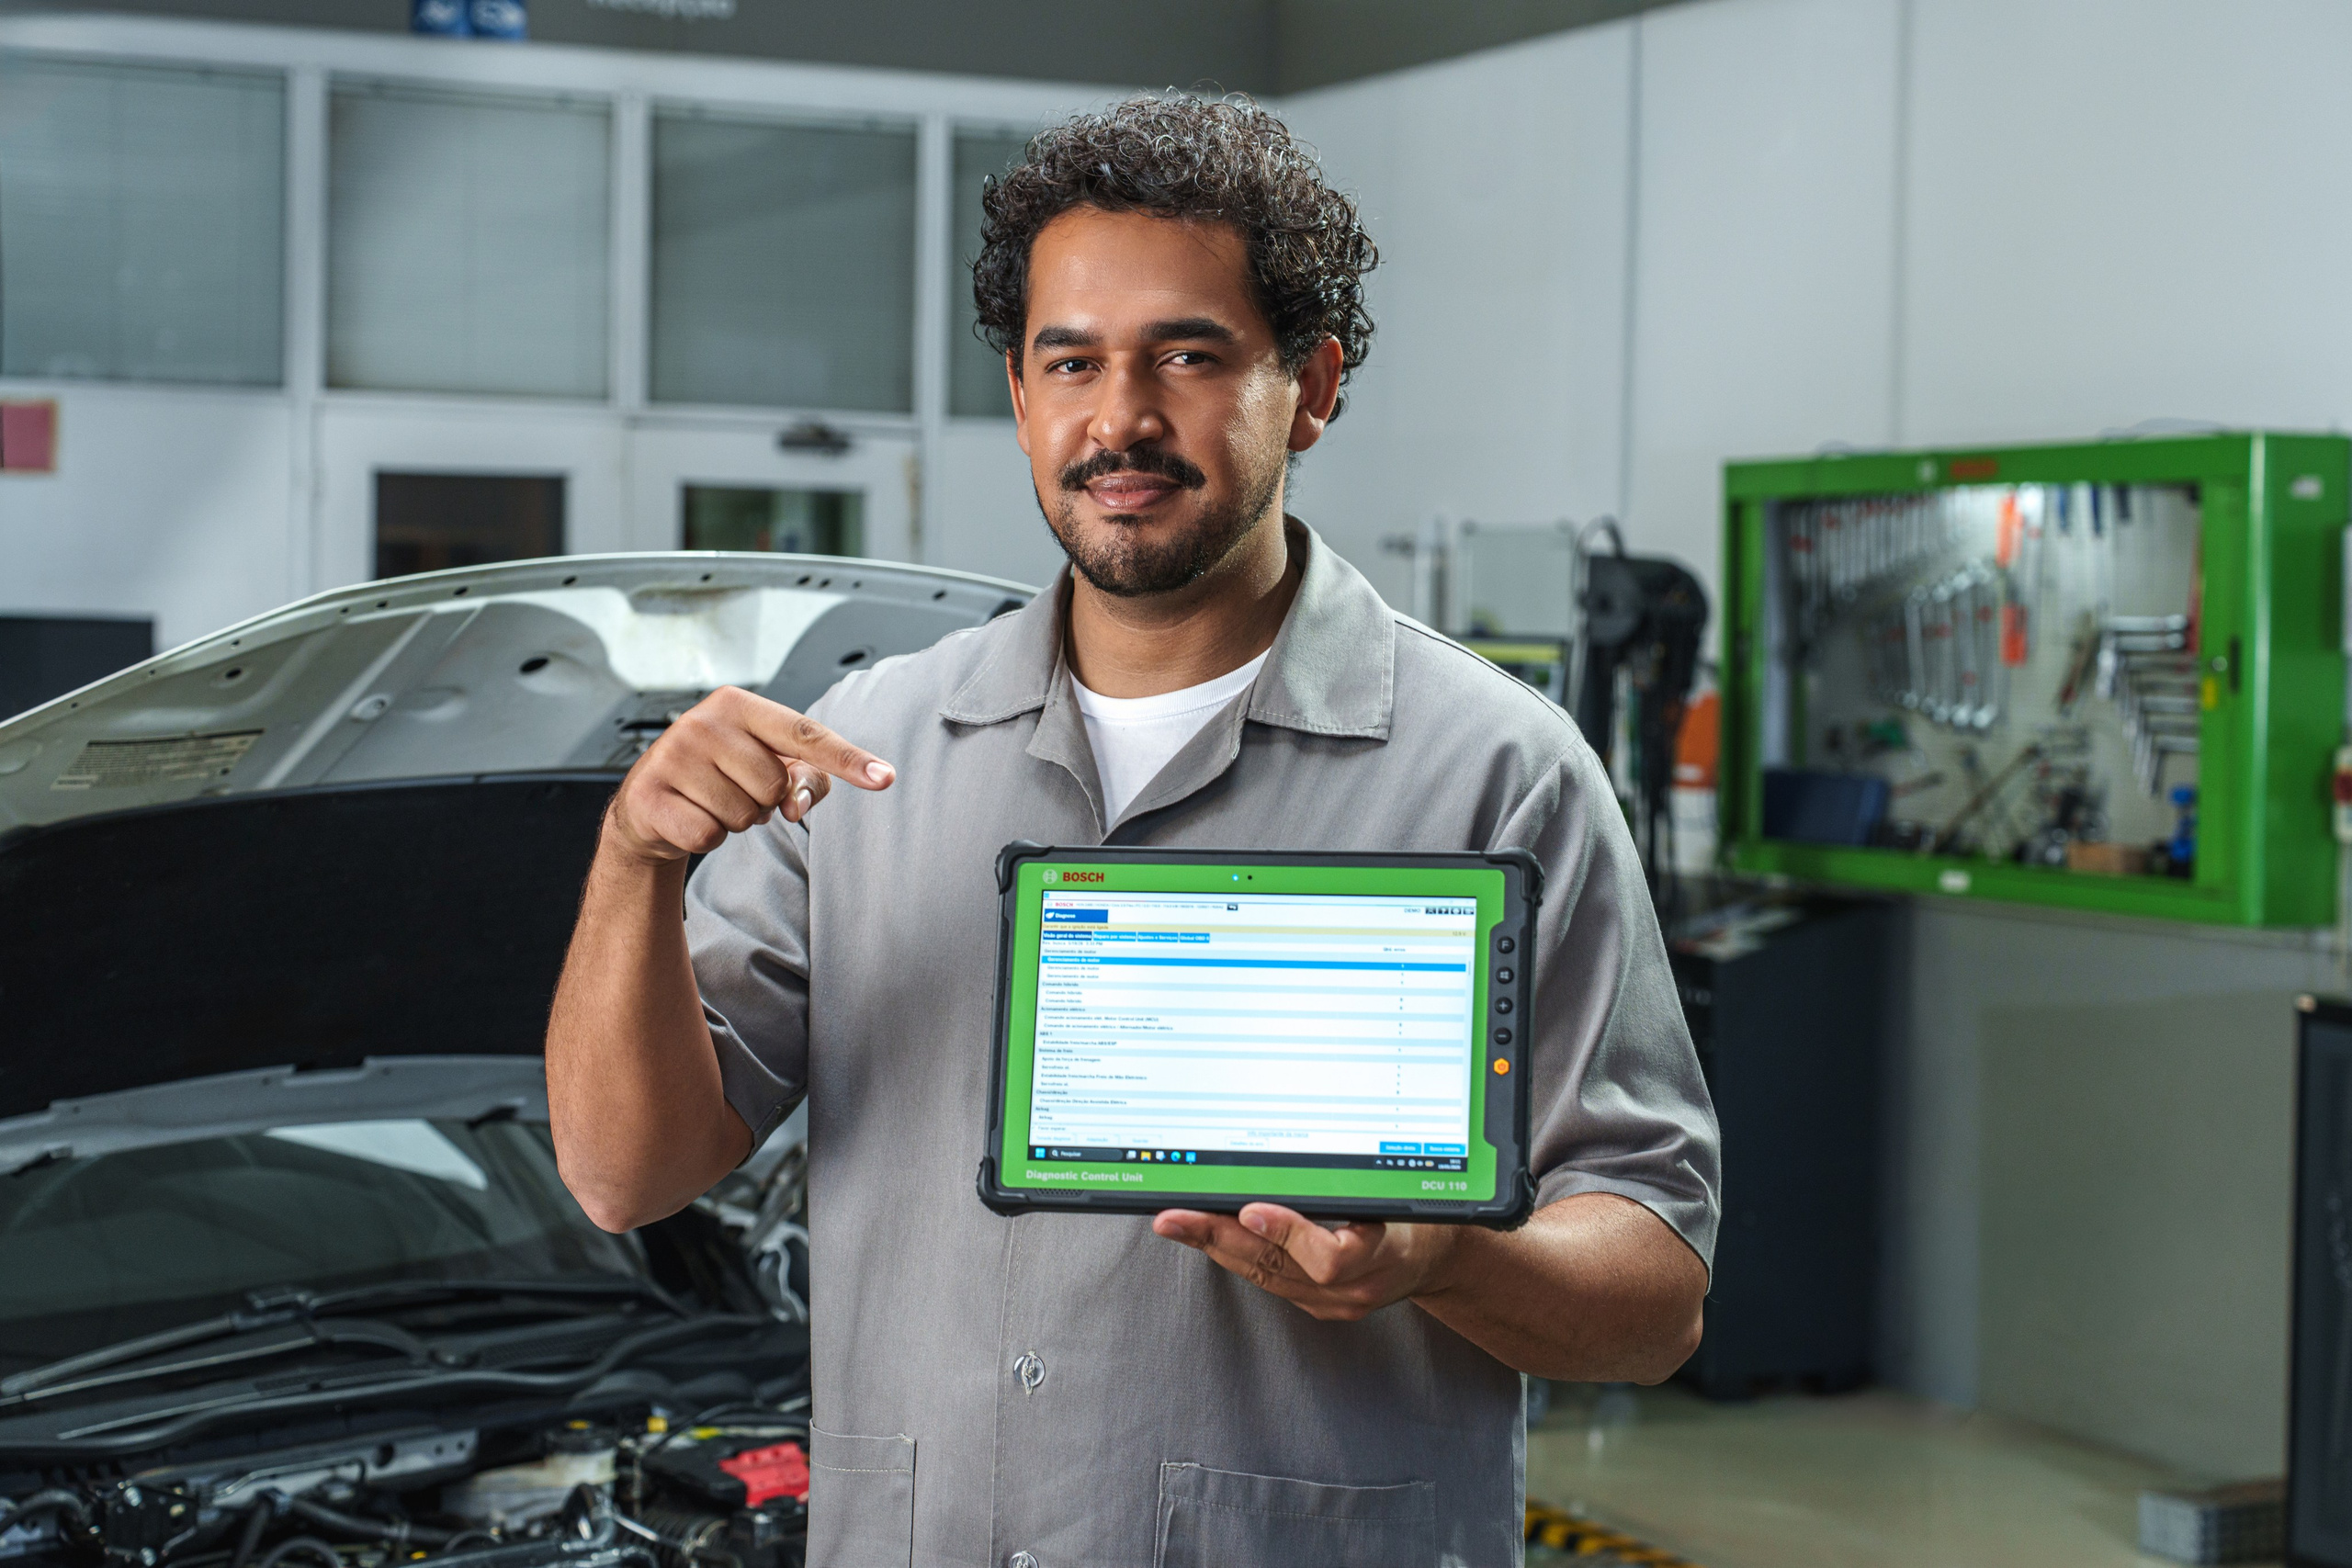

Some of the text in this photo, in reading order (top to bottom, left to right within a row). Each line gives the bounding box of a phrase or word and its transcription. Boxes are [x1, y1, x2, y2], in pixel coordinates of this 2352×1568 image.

[1063, 872, 1104, 883] BOSCH
[1501, 941, 1510, 950] F
[1026, 1169, 1143, 1182] Diagnostic Control Unit
[1421, 1180, 1467, 1190] DCU 110
